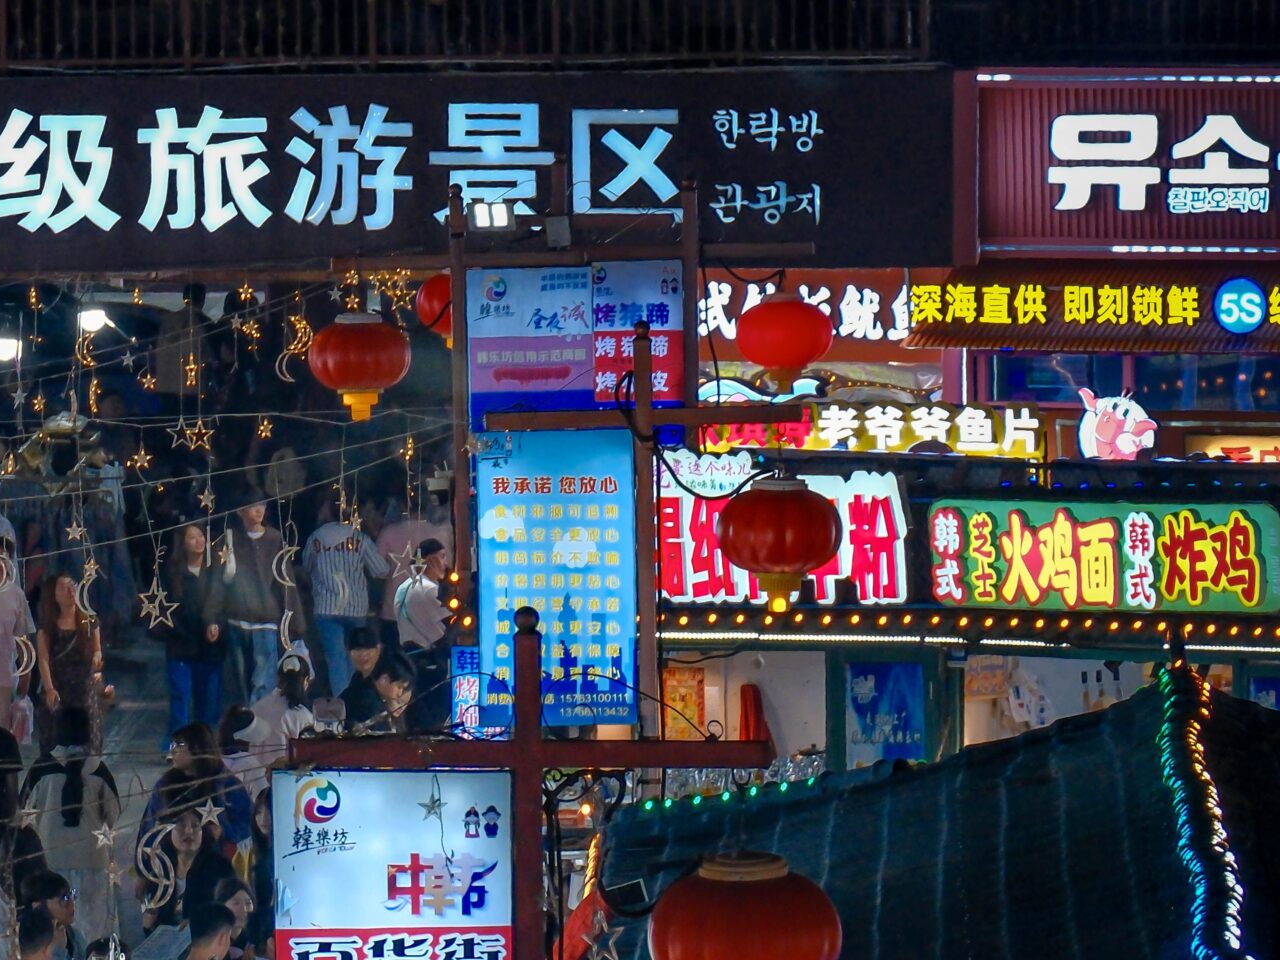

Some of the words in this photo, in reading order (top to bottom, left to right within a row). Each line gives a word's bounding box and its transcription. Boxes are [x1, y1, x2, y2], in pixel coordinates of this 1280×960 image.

[712, 108, 824, 153] 한락방
[1047, 114, 1280, 211] 유소
[709, 181, 821, 225] 관광지
[594, 302, 670, 327] 烤猪蹄
[911, 284, 1047, 325] 深海直供
[1063, 285, 1200, 327] 即刻锁鲜
[1220, 292, 1263, 324] 5S
[818, 404, 1040, 452] 老爷爷鱼片
[492, 476, 552, 494] 我承诺
[559, 476, 619, 494] 您放心
[933, 511, 962, 601] 韩式
[968, 513, 996, 602] 芝士
[999, 513, 1117, 604] 火鸡面
[1125, 511, 1155, 606] 韩式
[1161, 510, 1260, 608] 炸鸡
